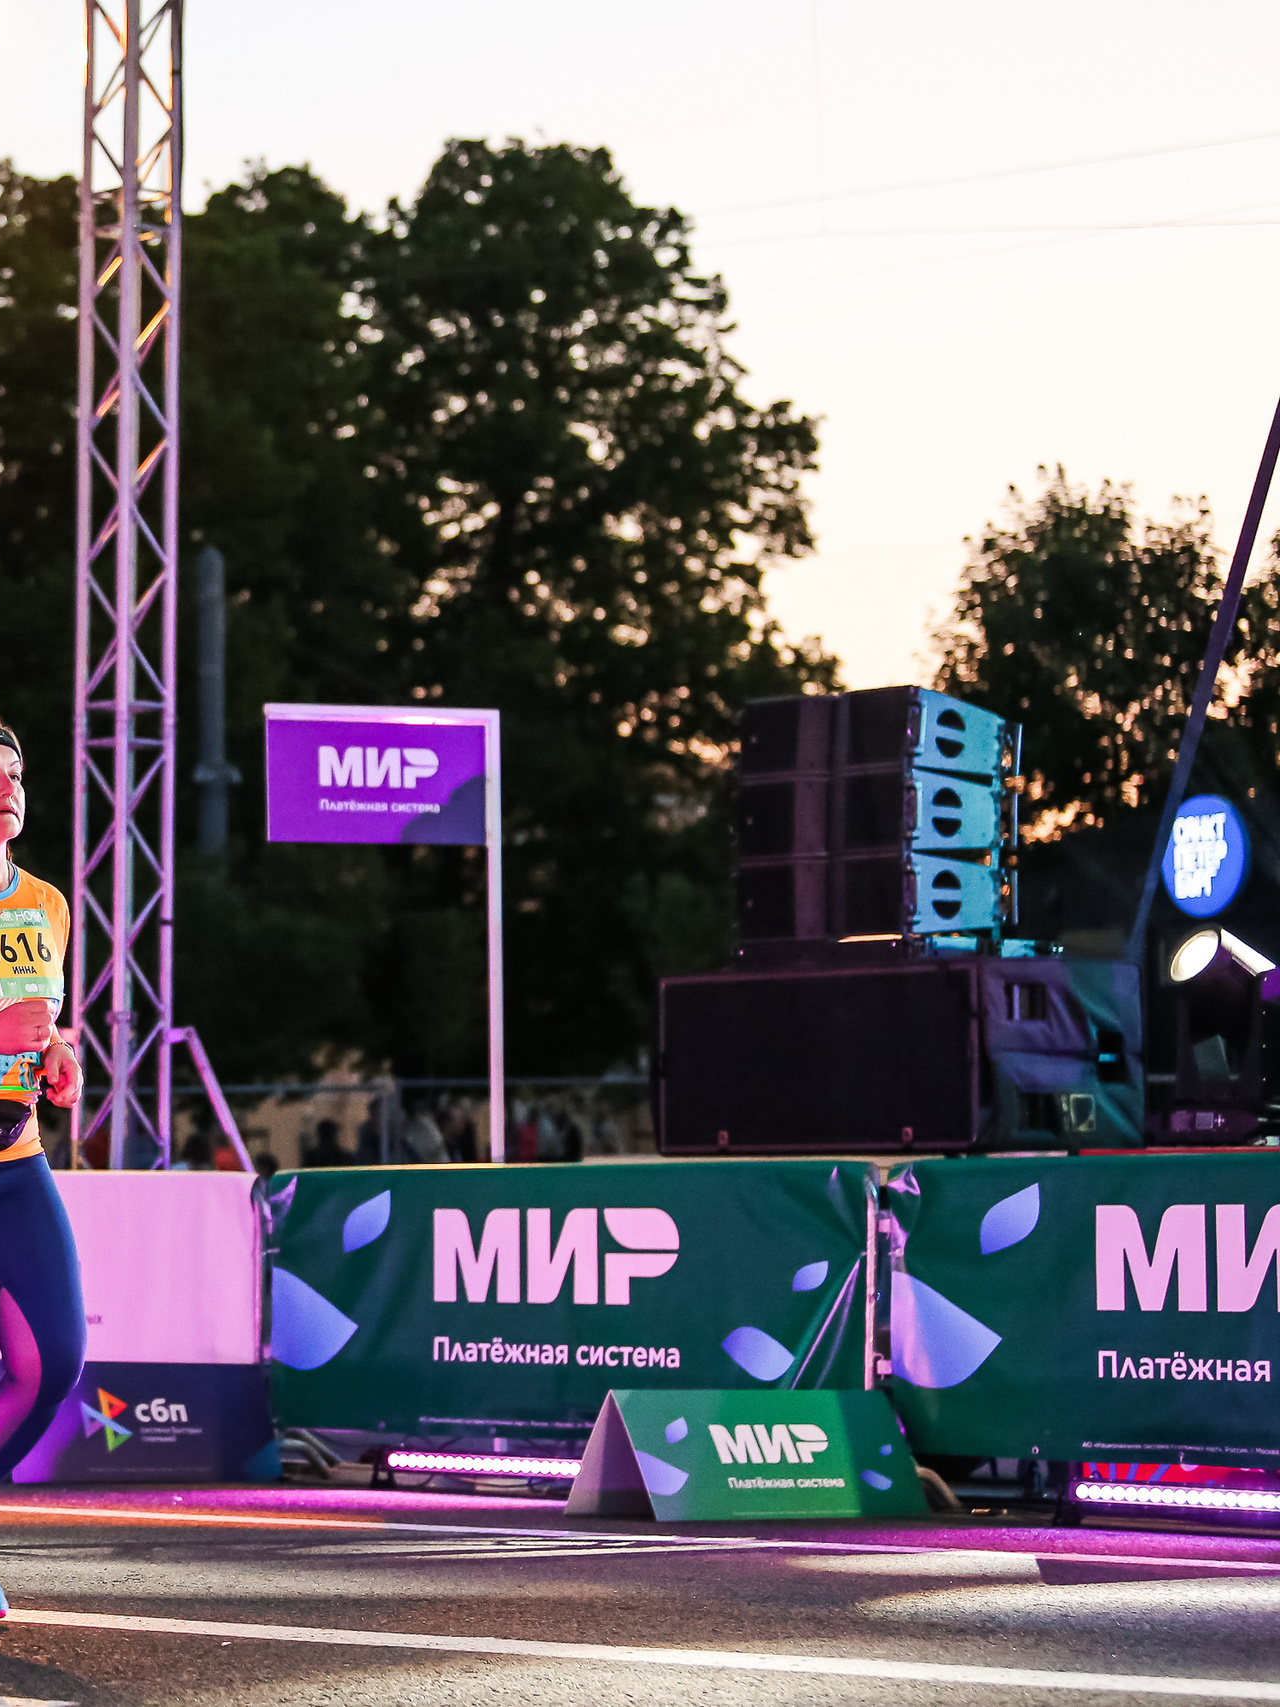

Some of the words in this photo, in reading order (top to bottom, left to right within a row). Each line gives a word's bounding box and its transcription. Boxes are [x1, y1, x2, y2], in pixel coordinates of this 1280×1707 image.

[319, 745, 439, 789] МИР
[320, 798, 388, 812] Платёжная
[390, 802, 440, 814] система
[12, 966, 37, 975] ИННА
[433, 1208, 680, 1306] МИР
[433, 1335, 569, 1365] Платёжная
[575, 1345, 681, 1369] система
[1097, 1350, 1271, 1383] Платёжная
[708, 1423, 829, 1464] МИР
[727, 1476, 795, 1489] Платёжная
[797, 1478, 846, 1488] система
